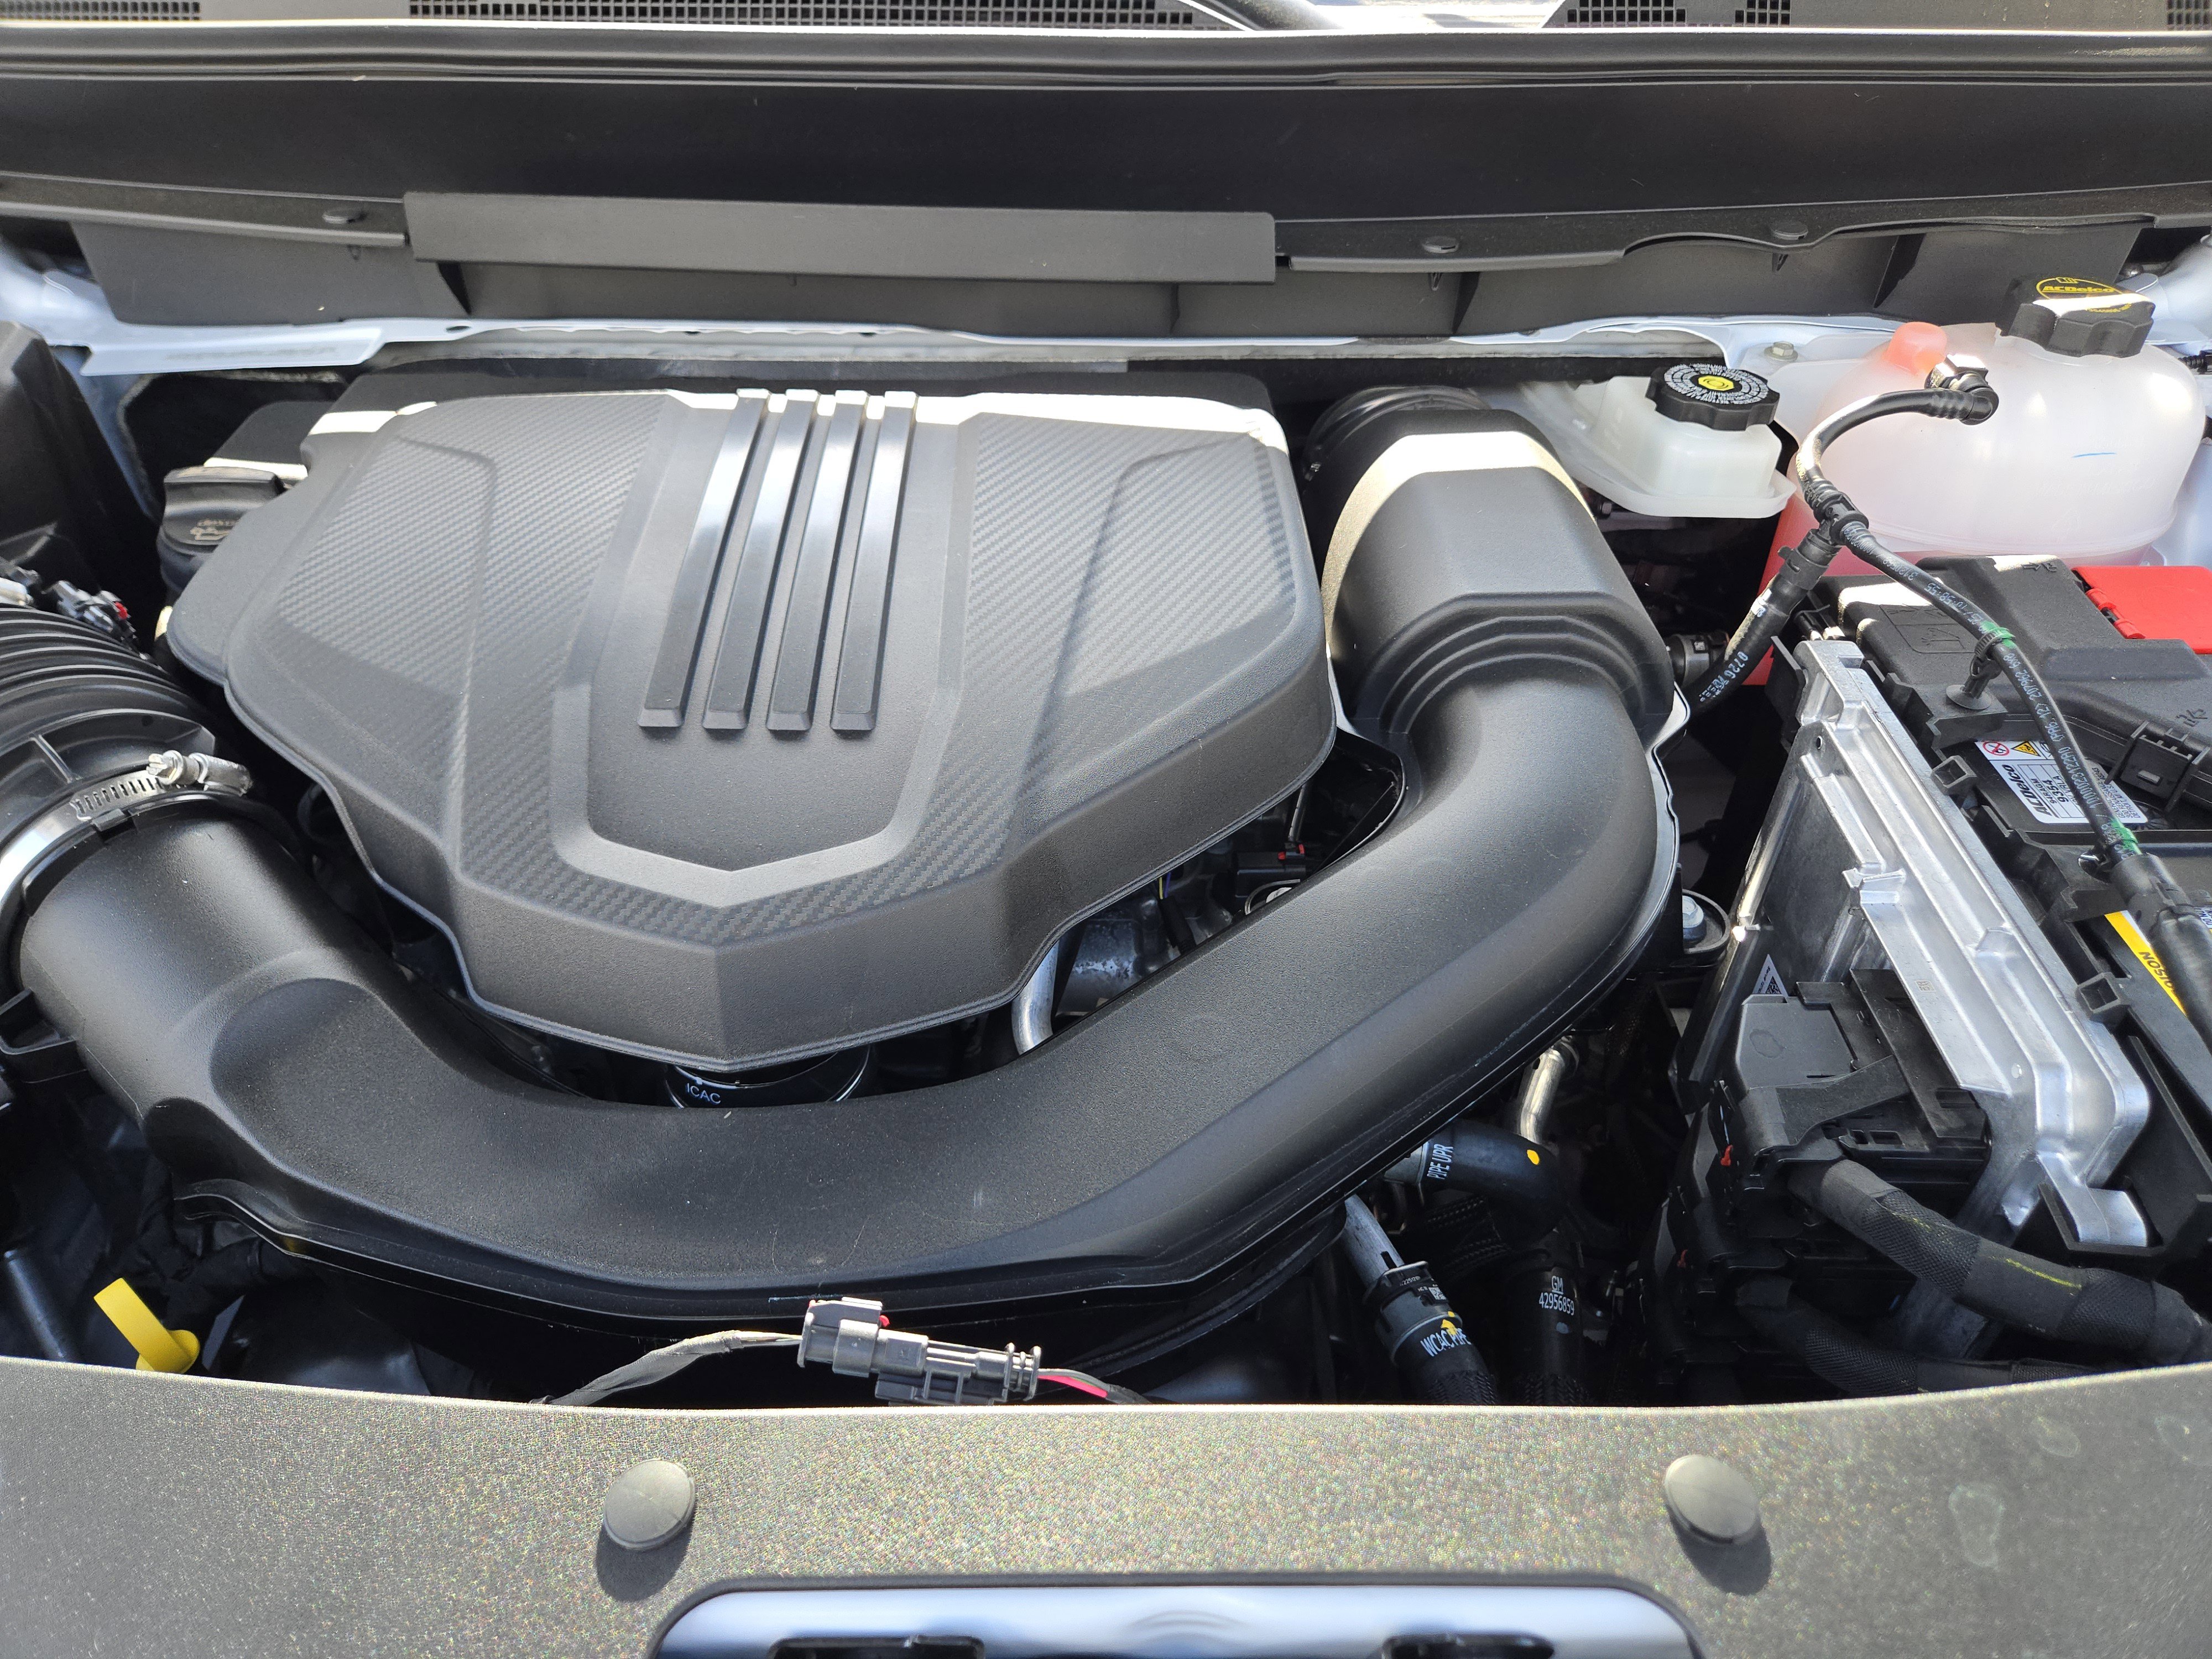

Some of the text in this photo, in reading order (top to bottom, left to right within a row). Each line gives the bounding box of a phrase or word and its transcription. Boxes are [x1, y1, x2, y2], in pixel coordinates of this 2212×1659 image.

[2001, 764, 2053, 816] ACDelco
[2030, 778, 2057, 804] 94RAGM
[2042, 779, 2069, 803] 9354
[2138, 951, 2176, 990] OISON
[685, 1082, 721, 1105] ICAC
[1427, 1144, 1454, 1180] PIPE UPR
[1551, 1275, 1564, 1292] GM
[1538, 1292, 1575, 1316] 42956859
[1420, 1330, 1455, 1357] WCAC
